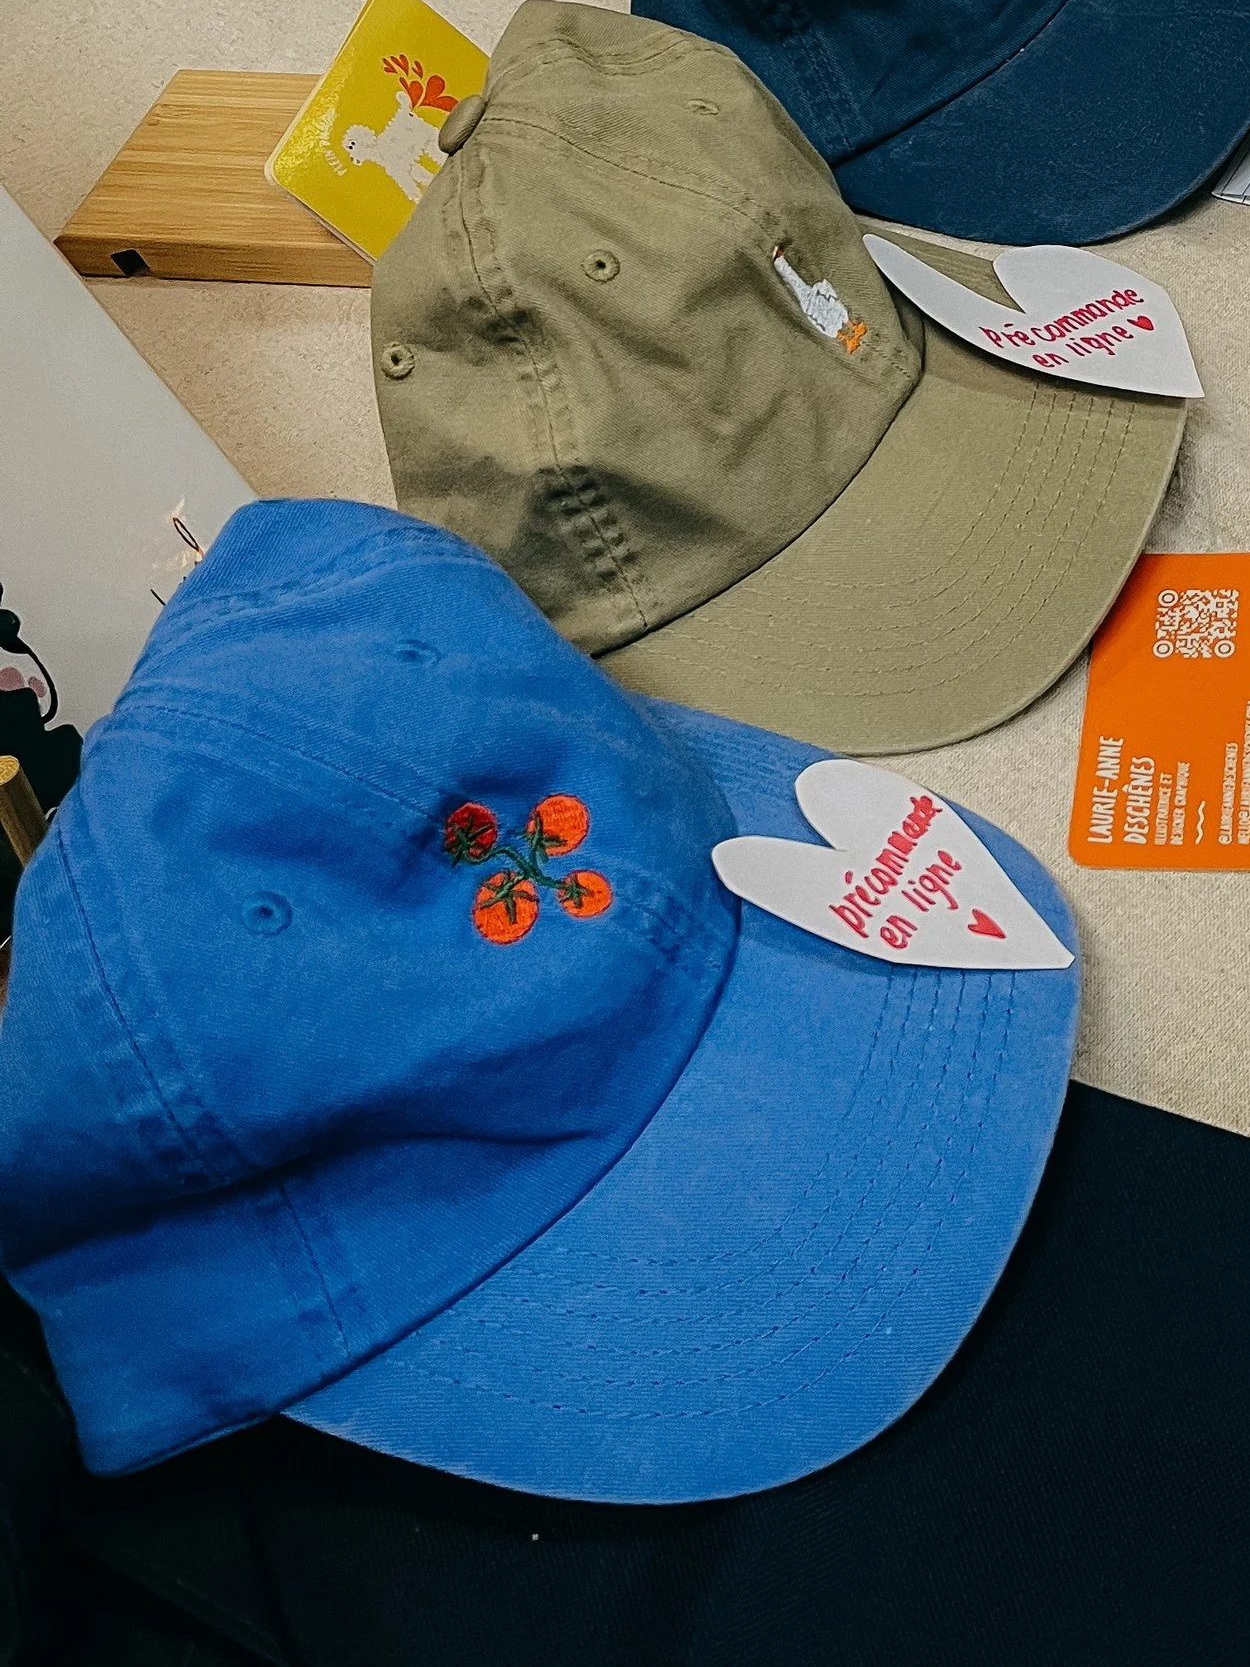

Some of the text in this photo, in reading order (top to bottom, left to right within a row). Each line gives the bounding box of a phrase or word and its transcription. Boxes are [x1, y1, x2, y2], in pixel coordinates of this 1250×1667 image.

[1032, 325, 1134, 368] en ligne
[1087, 735, 1124, 845] LAURIE-ANNE
[1121, 756, 1155, 845] DESCHÊNES
[880, 849, 962, 949] en ligne
